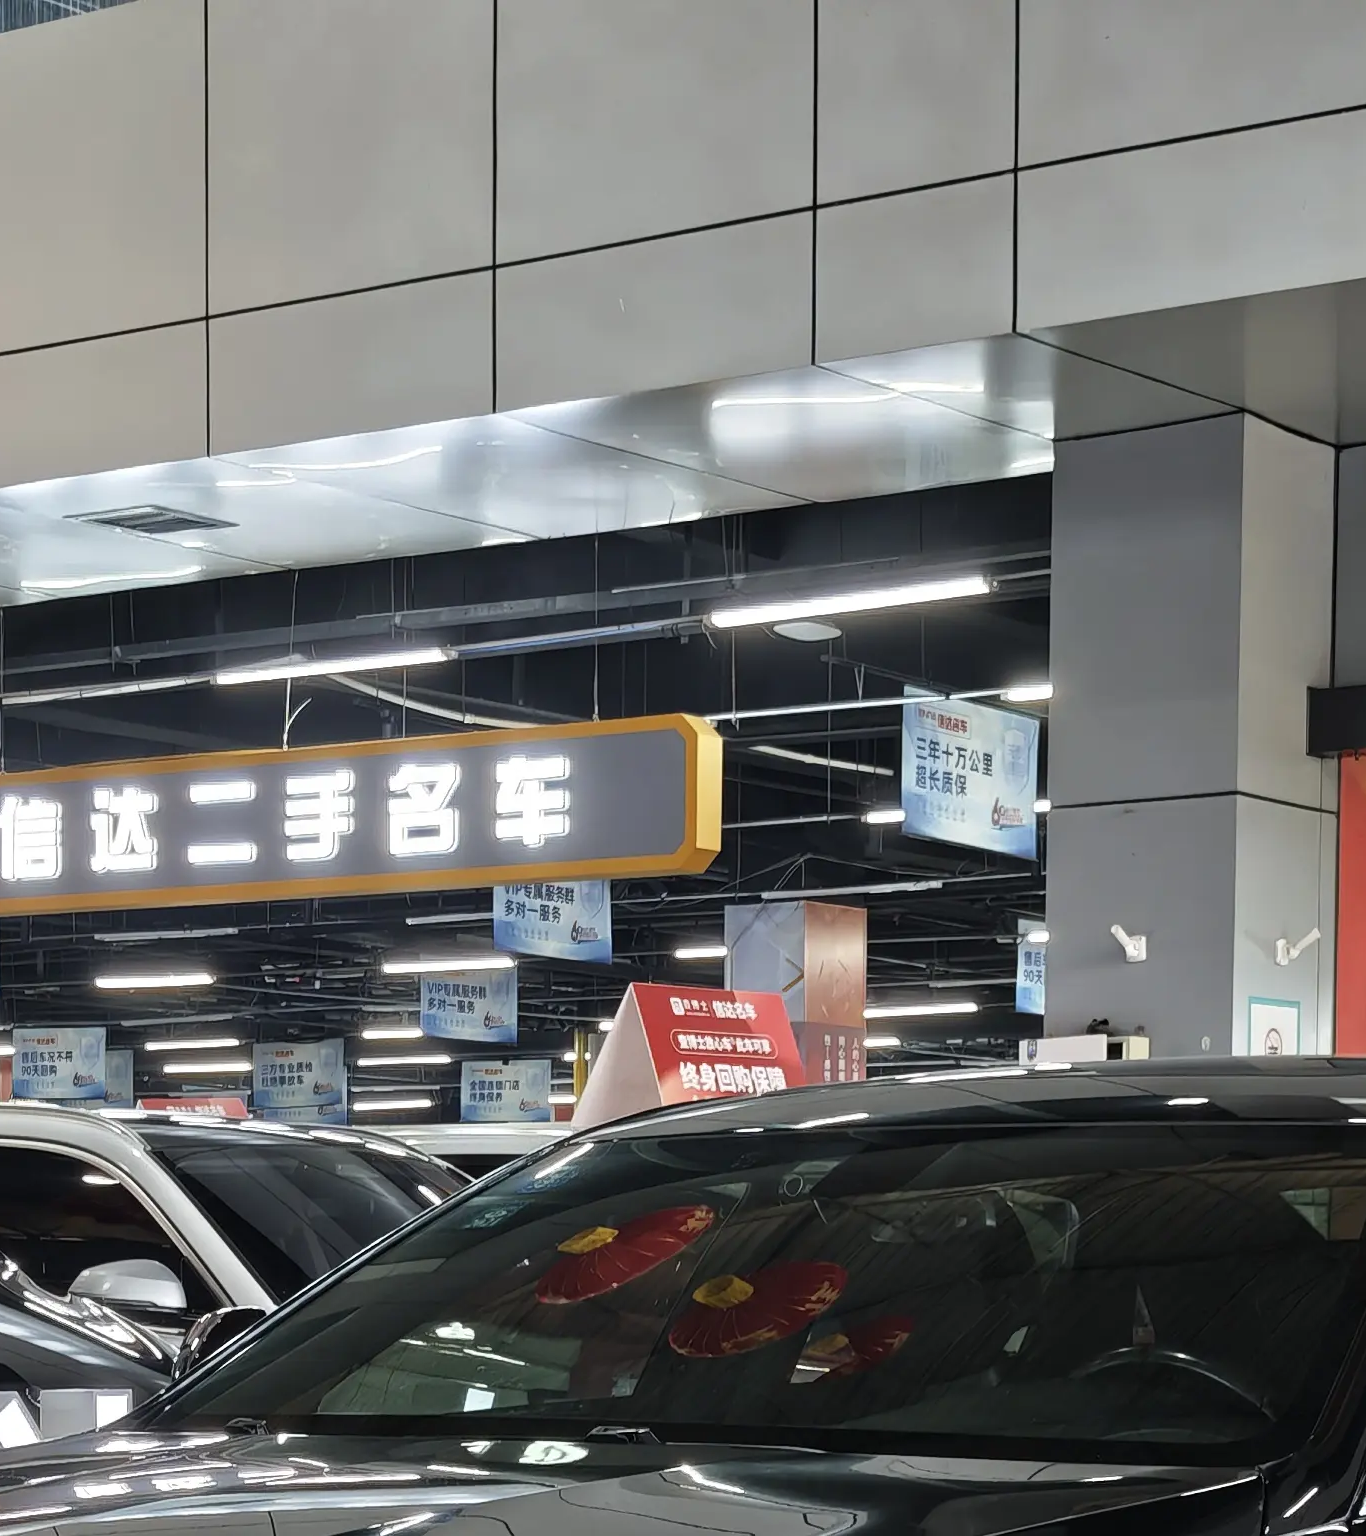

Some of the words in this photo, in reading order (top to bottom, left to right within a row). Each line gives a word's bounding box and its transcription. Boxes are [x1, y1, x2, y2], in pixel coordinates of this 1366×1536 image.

[915, 736, 993, 777] 三年十万公里
[915, 764, 968, 797] 超长质保
[504, 899, 562, 924] 多对一服务
[678, 1061, 787, 1097] 终身回购保障
